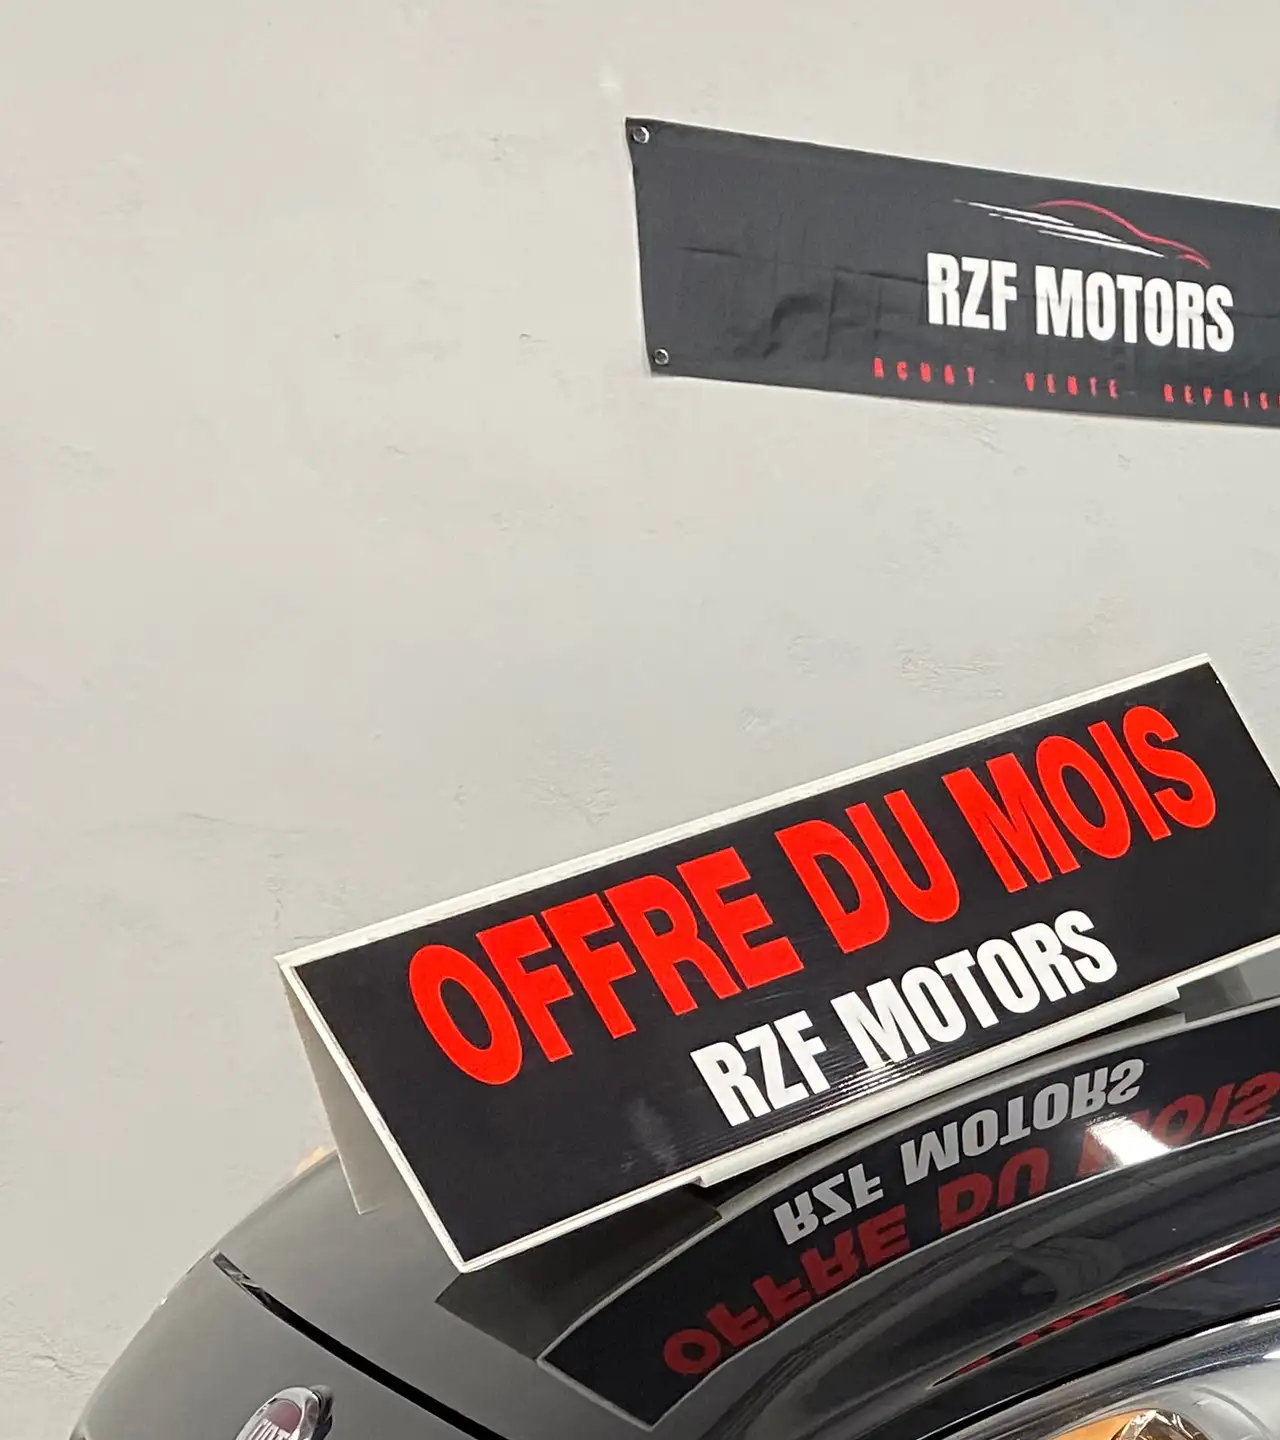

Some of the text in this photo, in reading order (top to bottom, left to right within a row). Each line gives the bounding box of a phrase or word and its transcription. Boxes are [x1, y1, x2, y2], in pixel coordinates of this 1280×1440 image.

[927, 252, 1235, 353] RZF MOTORS
[407, 705, 1217, 1086] OFFRE DU MOIS
[690, 910, 1118, 1127] RZF MOTORS
